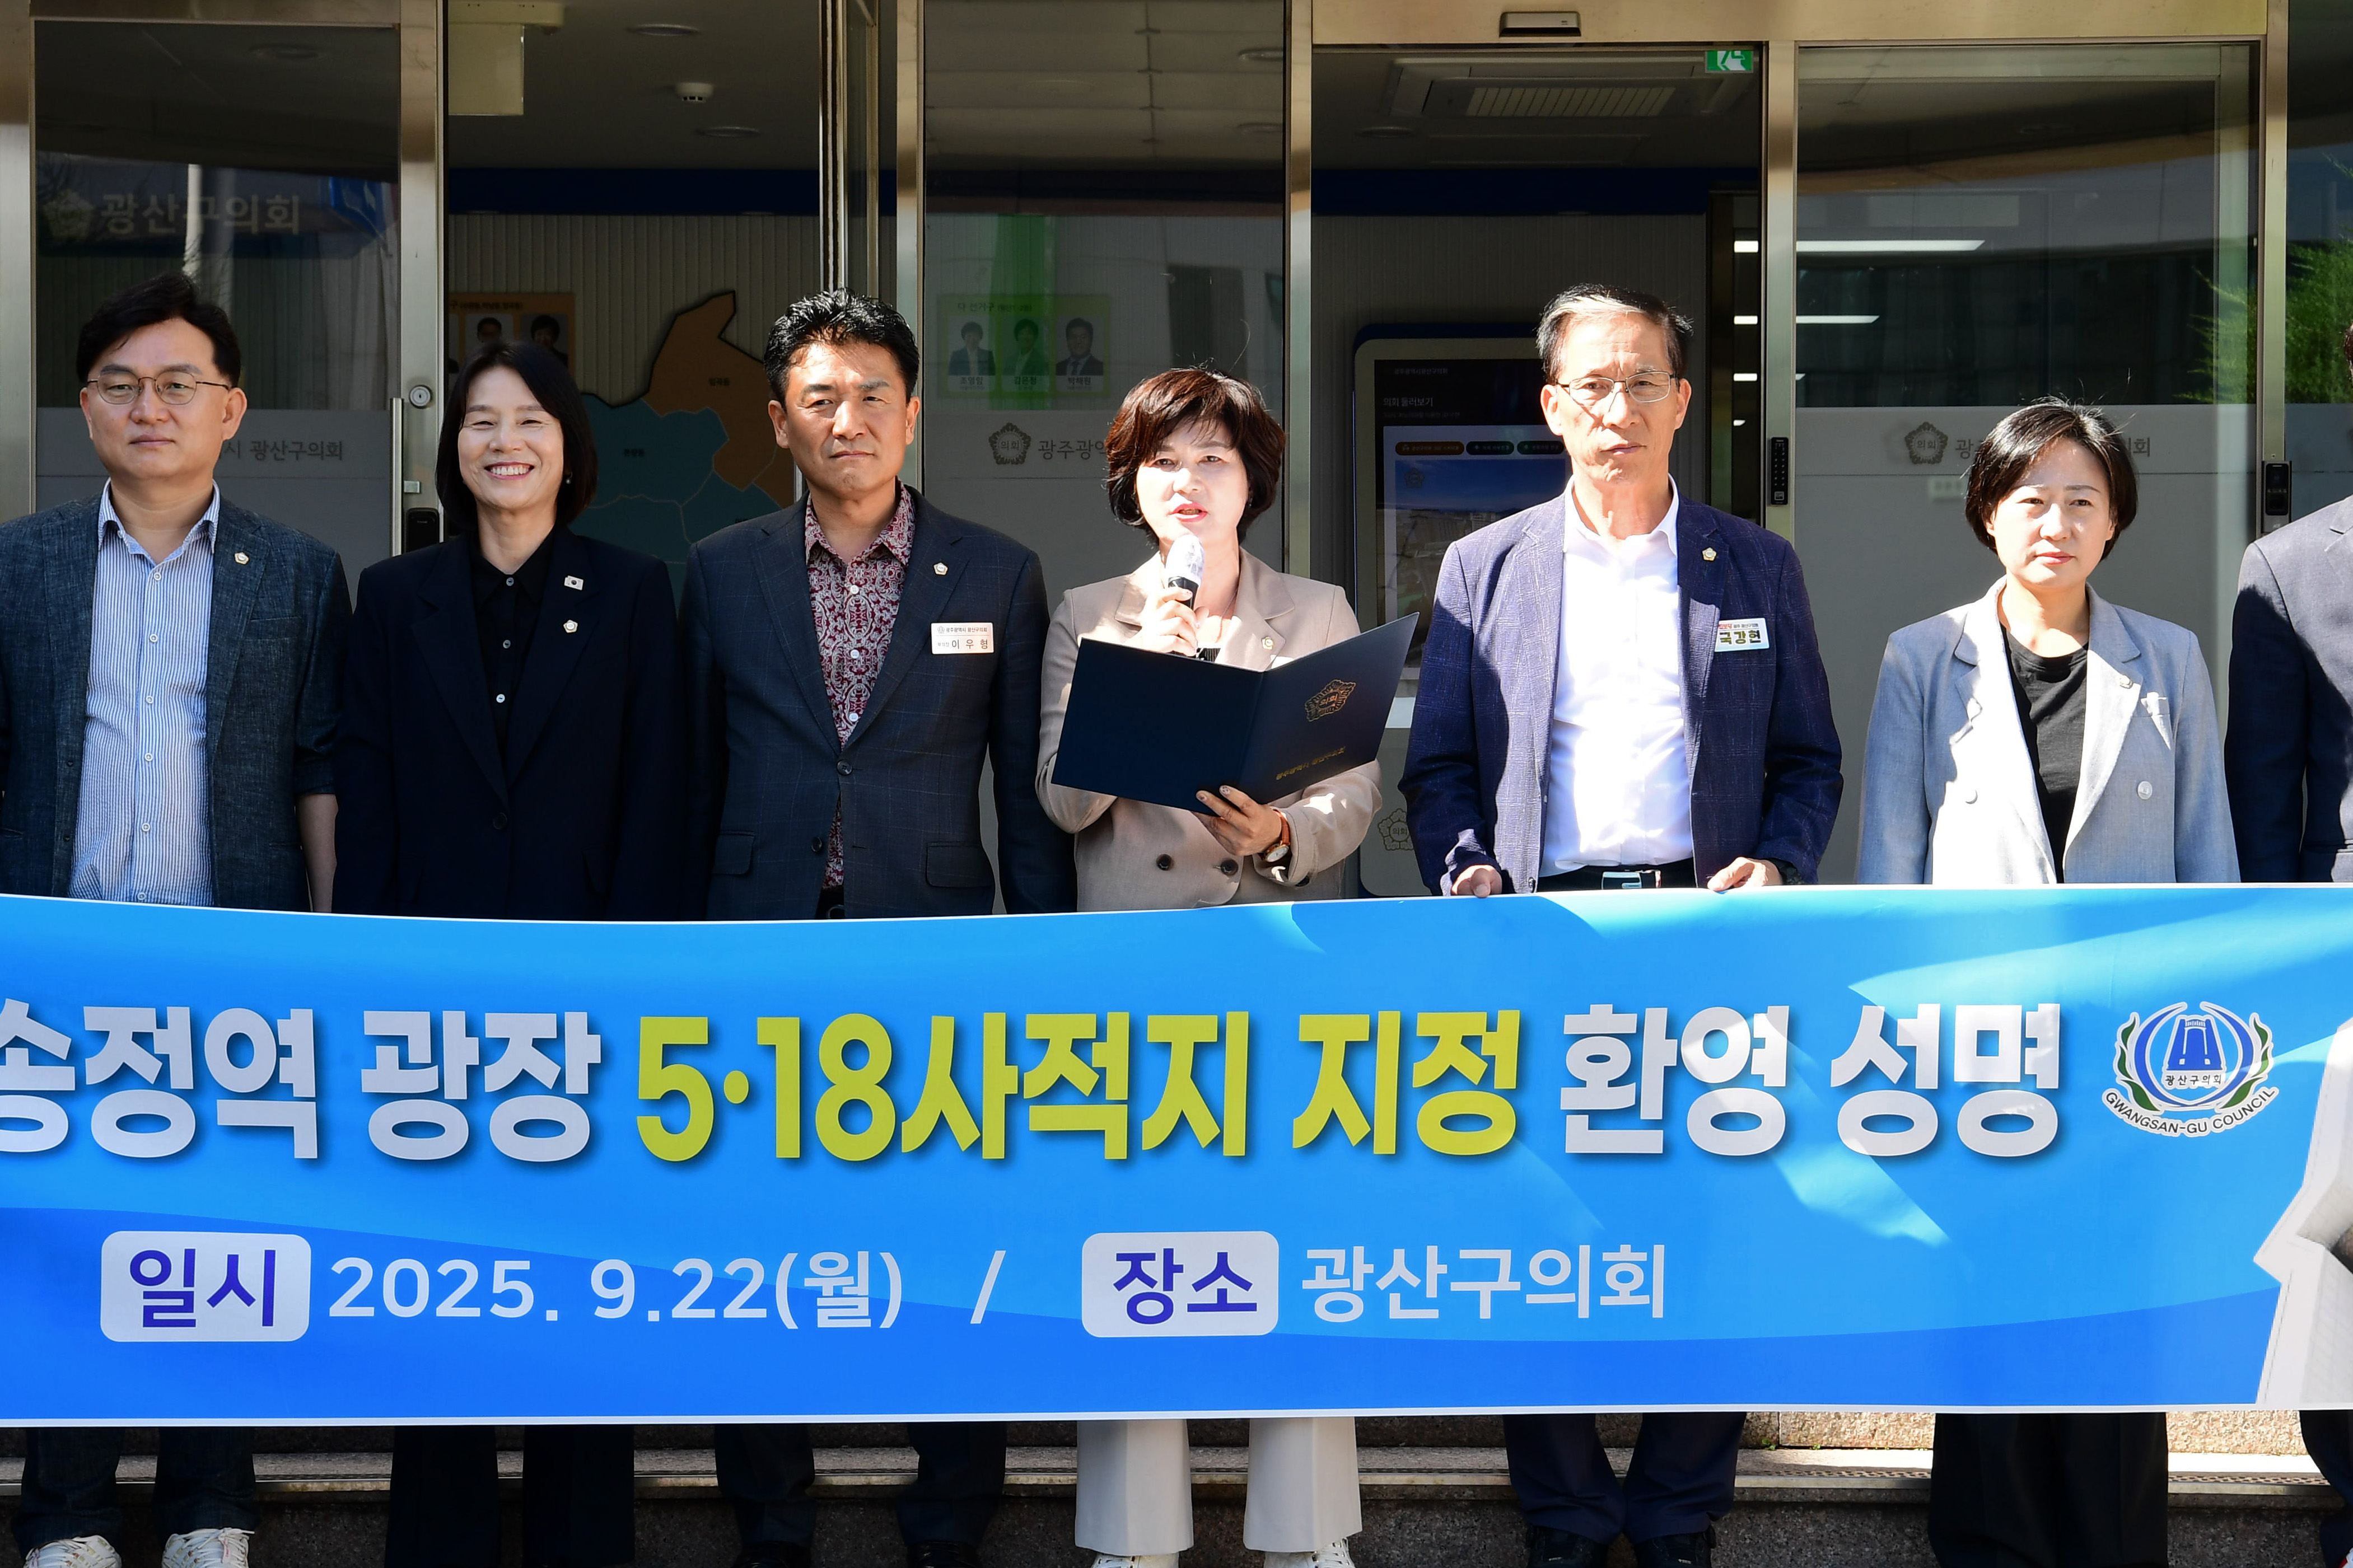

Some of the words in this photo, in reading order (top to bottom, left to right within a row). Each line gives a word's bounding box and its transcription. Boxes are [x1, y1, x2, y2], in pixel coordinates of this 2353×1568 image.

[101, 194, 300, 235] 광산구의회
[1383, 397, 1399, 407] 의회
[1402, 397, 1434, 407] 둘러보기
[250, 440, 343, 461] 광산구의회
[1001, 440, 1020, 451] 의회
[1917, 439, 1936, 449] 의회
[1719, 630, 1762, 644] 국강현
[1393, 827, 1408, 836] 의회
[0, 999, 318, 1159] 송정역
[361, 1010, 601, 1162] 광장
[1294, 1010, 1521, 1155] 지정
[1560, 1004, 1790, 1157] 환영
[1831, 1003, 2061, 1158] 성명
[2165, 1074, 2222, 1085] 광산구의회
[2105, 1092, 2207, 1134] GWANGSAN-GU
[2212, 1089, 2275, 1130] COUNCIL
[130, 1248, 276, 1328] 일시
[329, 1257, 558, 1322] 2025.
[591, 1251, 902, 1330] 9.22(월)
[1113, 1248, 1258, 1325] 장소
[1302, 1244, 1665, 1323] 광산구의회
